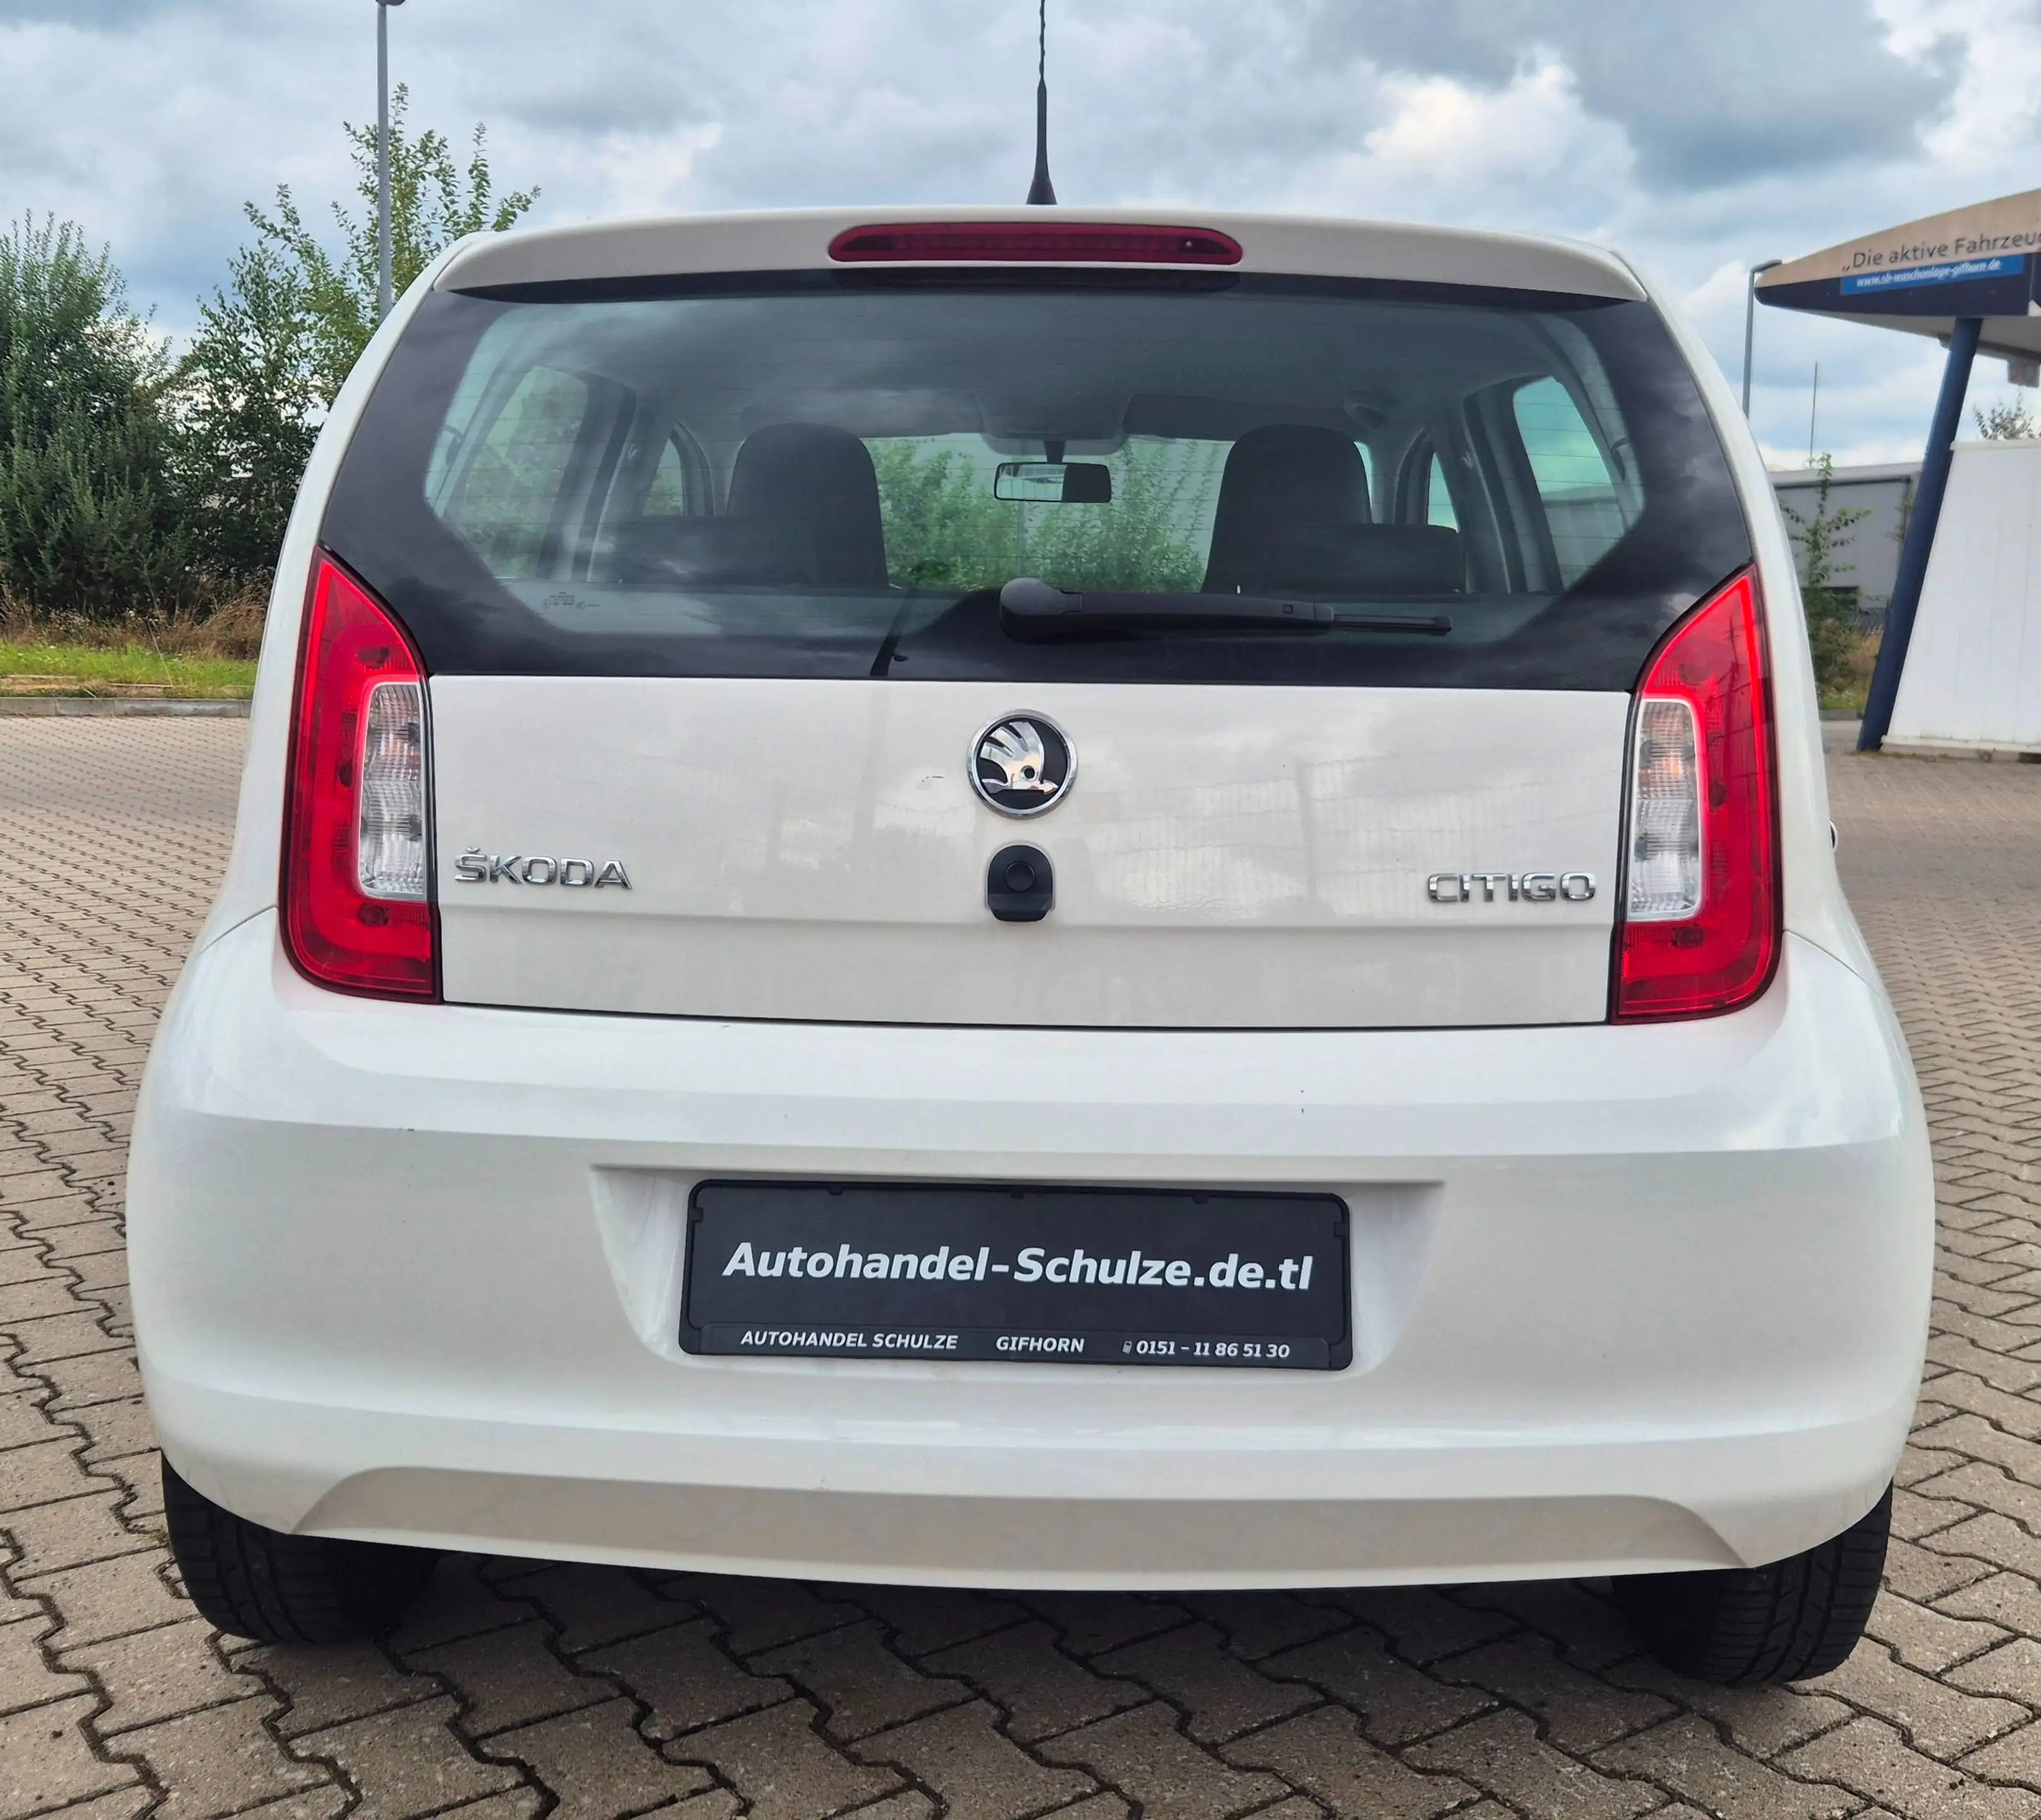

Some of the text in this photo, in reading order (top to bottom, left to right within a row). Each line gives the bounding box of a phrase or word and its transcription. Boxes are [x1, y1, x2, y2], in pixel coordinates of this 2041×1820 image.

[1889, 243, 1948, 264] aktive
[454, 847, 633, 890] ŠKODA
[1428, 871, 1597, 902] CITIGO
[722, 1242, 1313, 1290] Autohandel-Schulze.de.tl
[740, 1331, 867, 1348] AUTOHANDEL
[872, 1333, 959, 1349] SCHULZE
[996, 1337, 1085, 1353] GIFHORN
[1136, 1340, 1176, 1356] 0151
[1193, 1342, 1210, 1356] 11
[1215, 1342, 1238, 1357] 86
[1243, 1342, 1262, 1357] 51
[1265, 1344, 1291, 1358] 30
